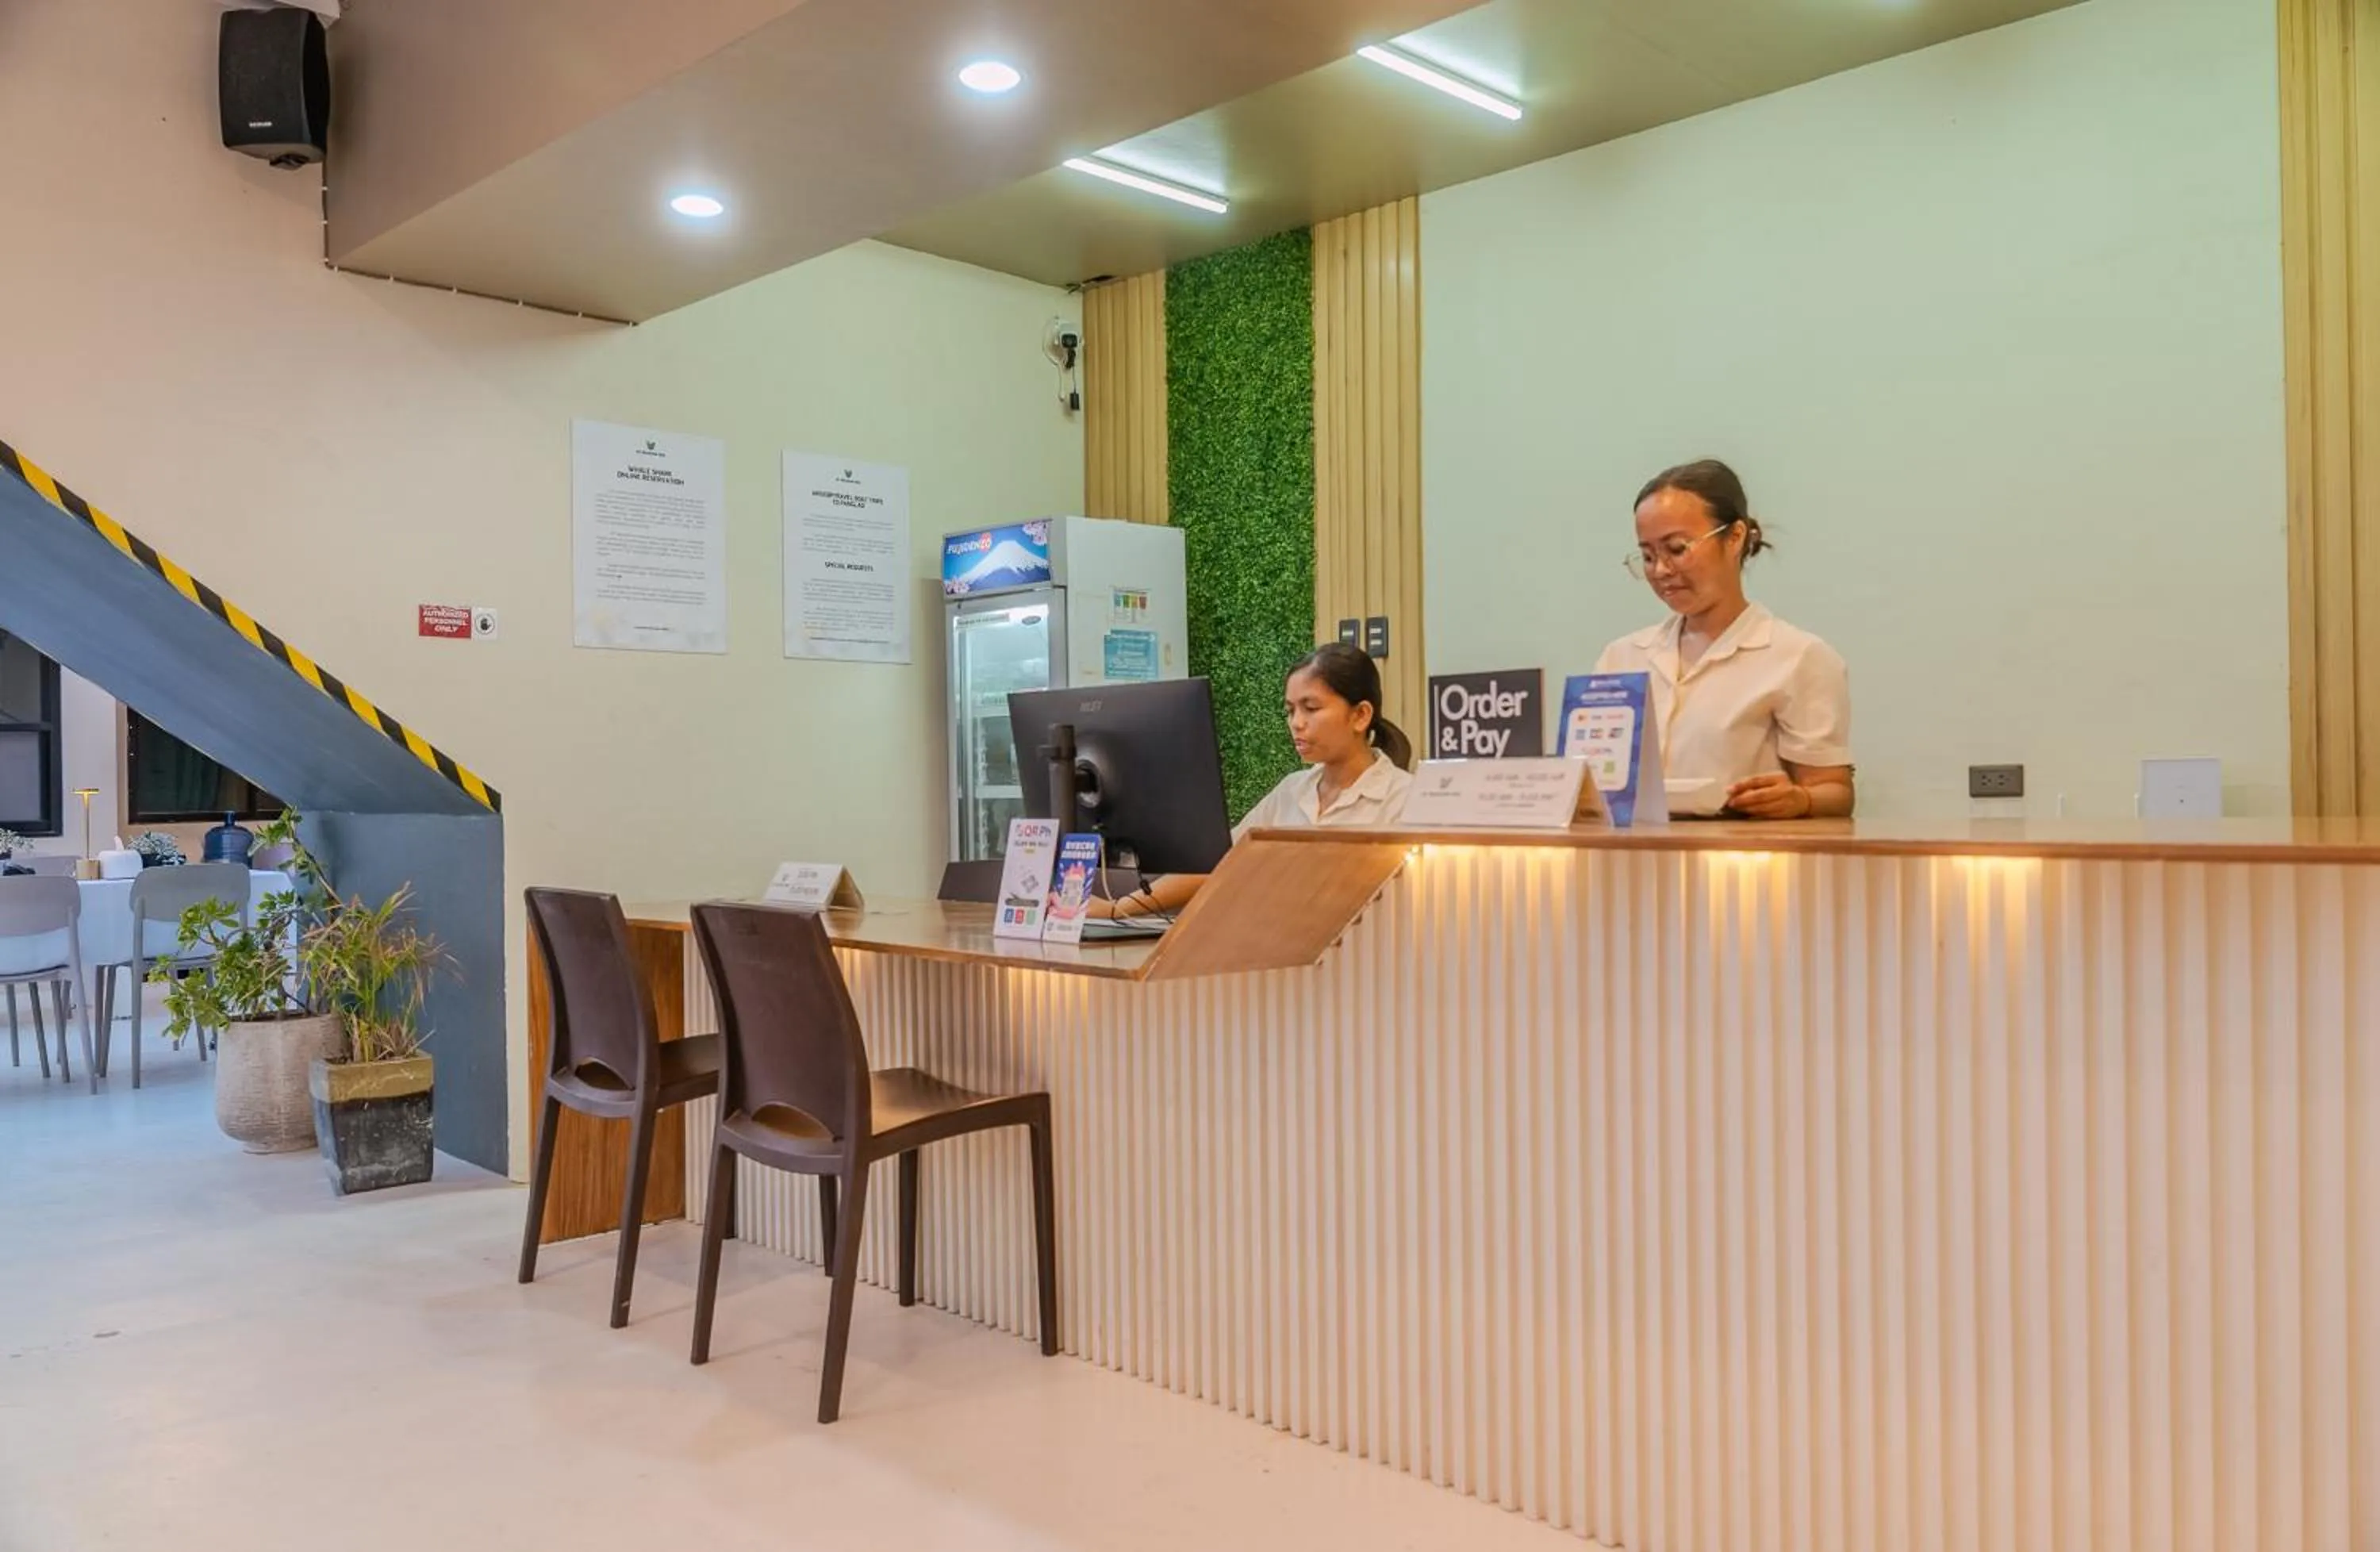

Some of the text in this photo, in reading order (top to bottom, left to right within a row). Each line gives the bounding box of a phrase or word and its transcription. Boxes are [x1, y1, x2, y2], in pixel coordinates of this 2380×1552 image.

[434, 624, 459, 633] ONLY
[1441, 680, 1529, 720] Order
[1441, 720, 1511, 759] & Pay
